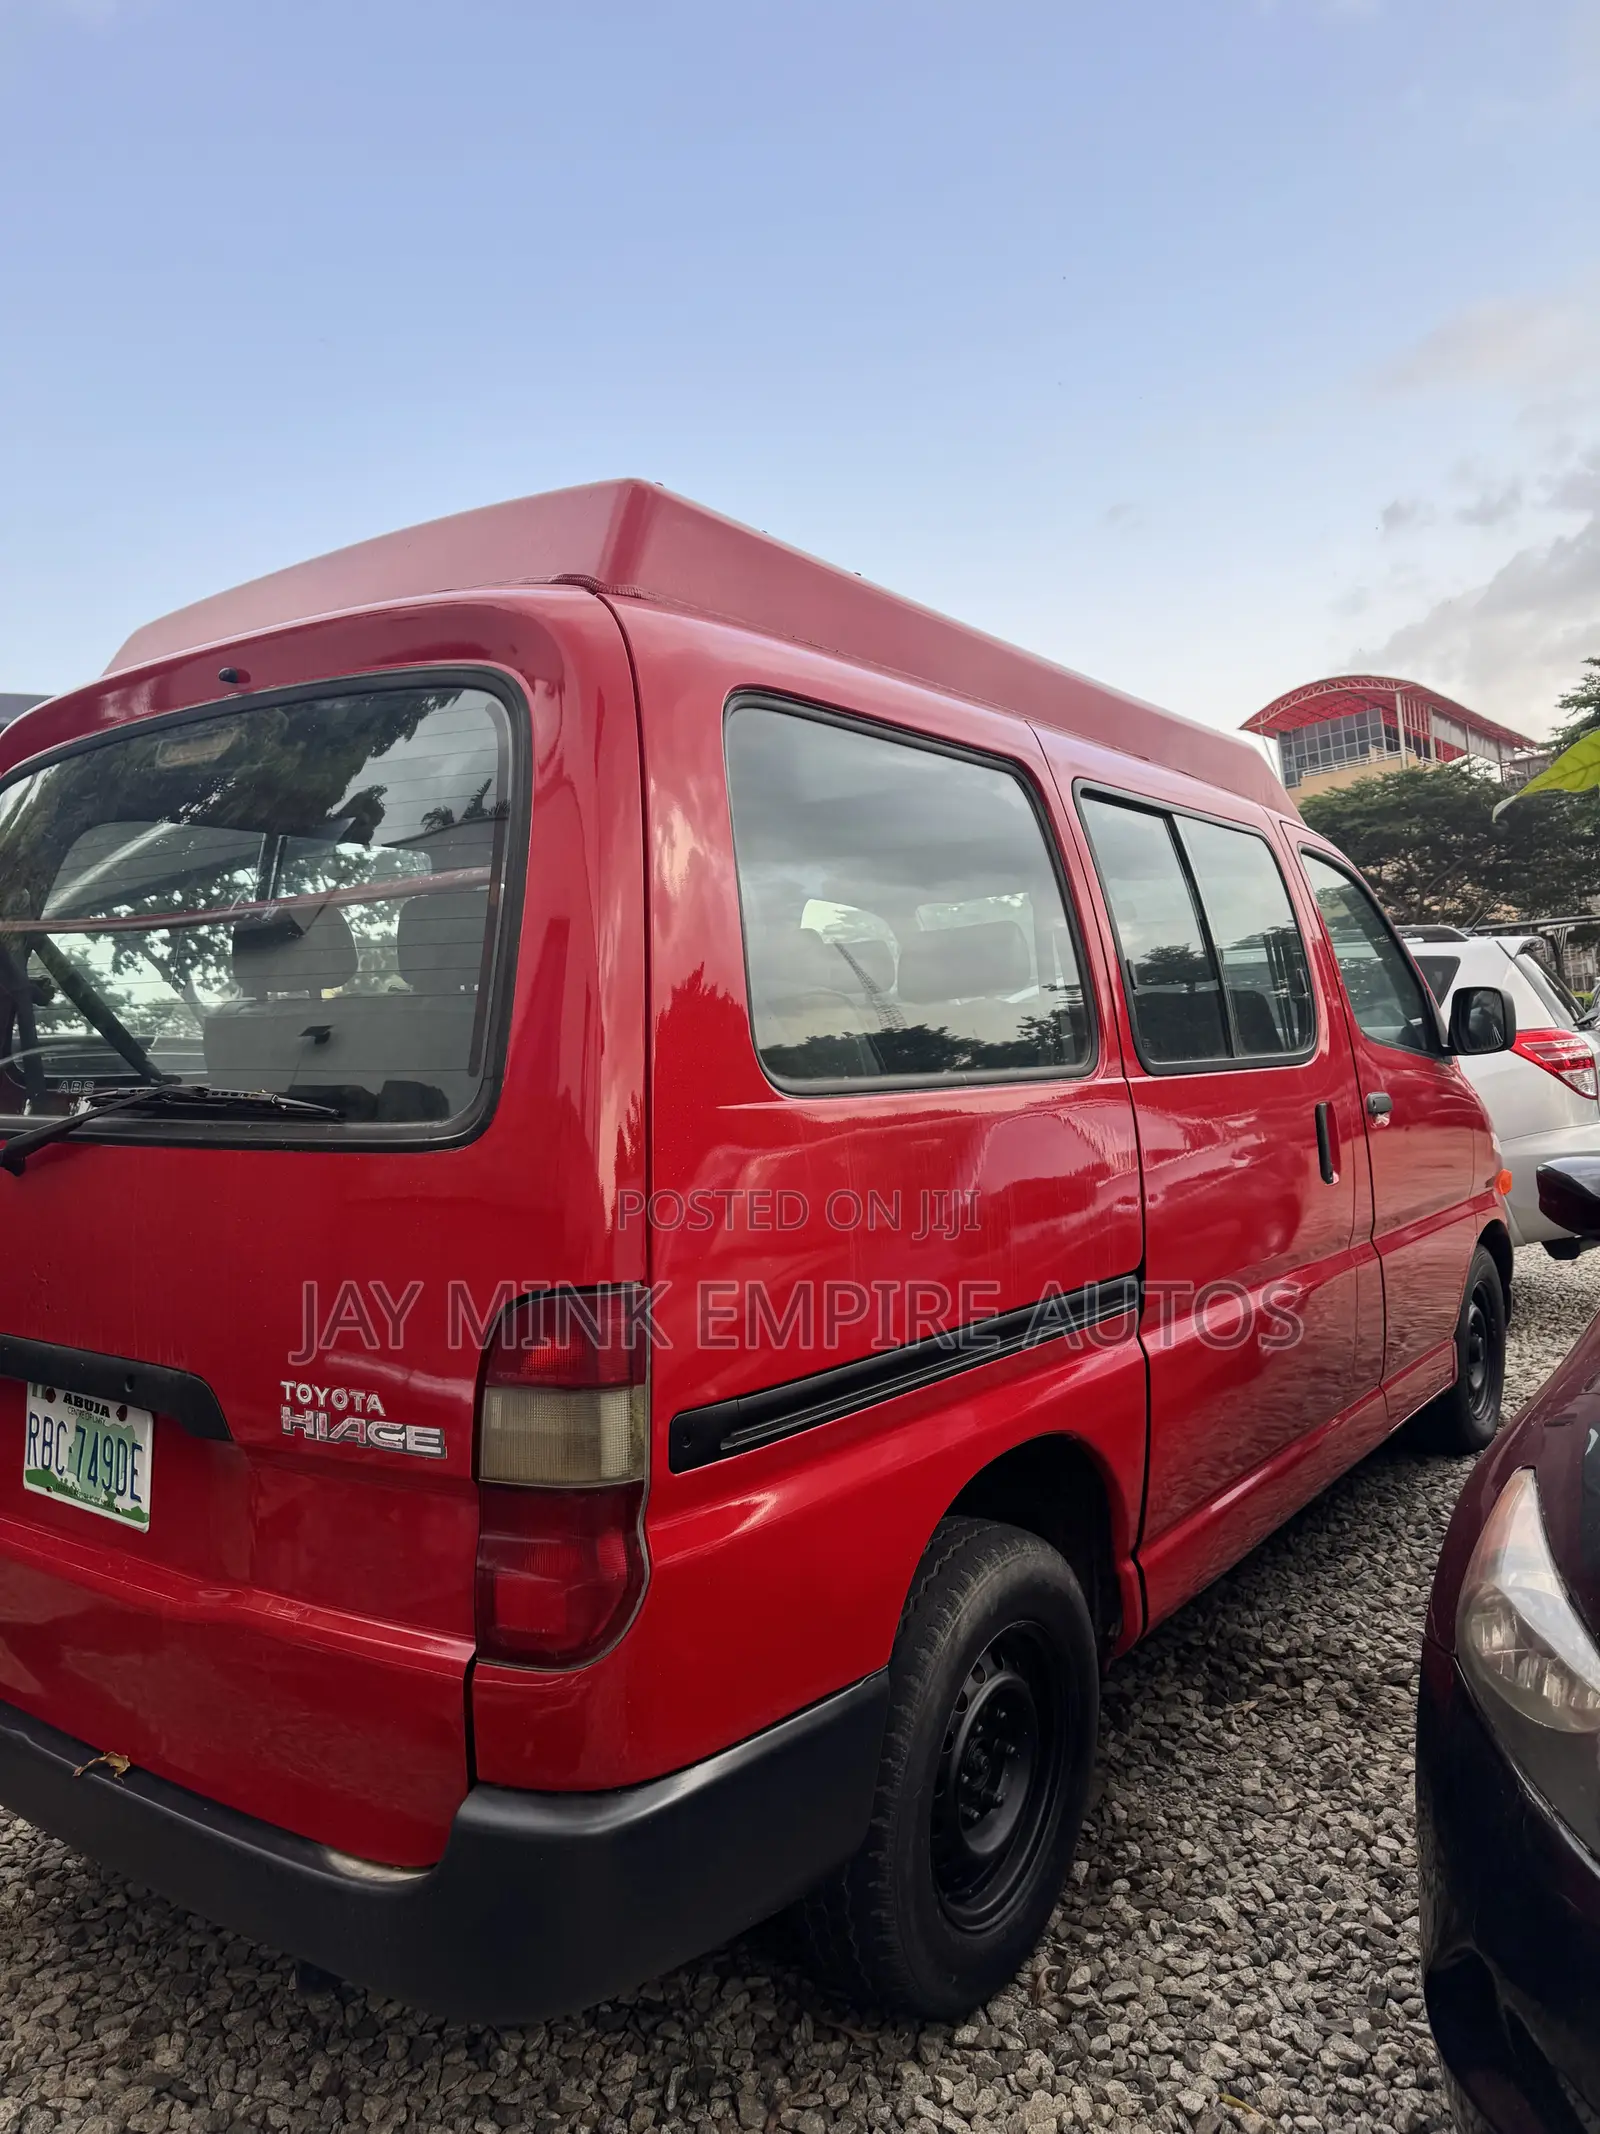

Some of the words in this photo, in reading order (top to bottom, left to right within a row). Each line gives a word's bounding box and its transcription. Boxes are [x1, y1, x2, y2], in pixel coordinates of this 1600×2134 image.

[58, 1081, 94, 1093] ABS
[62, 1392, 110, 1418] ABUJA
[280, 1381, 386, 1416] TOYOTA
[281, 1405, 447, 1459] HIACE
